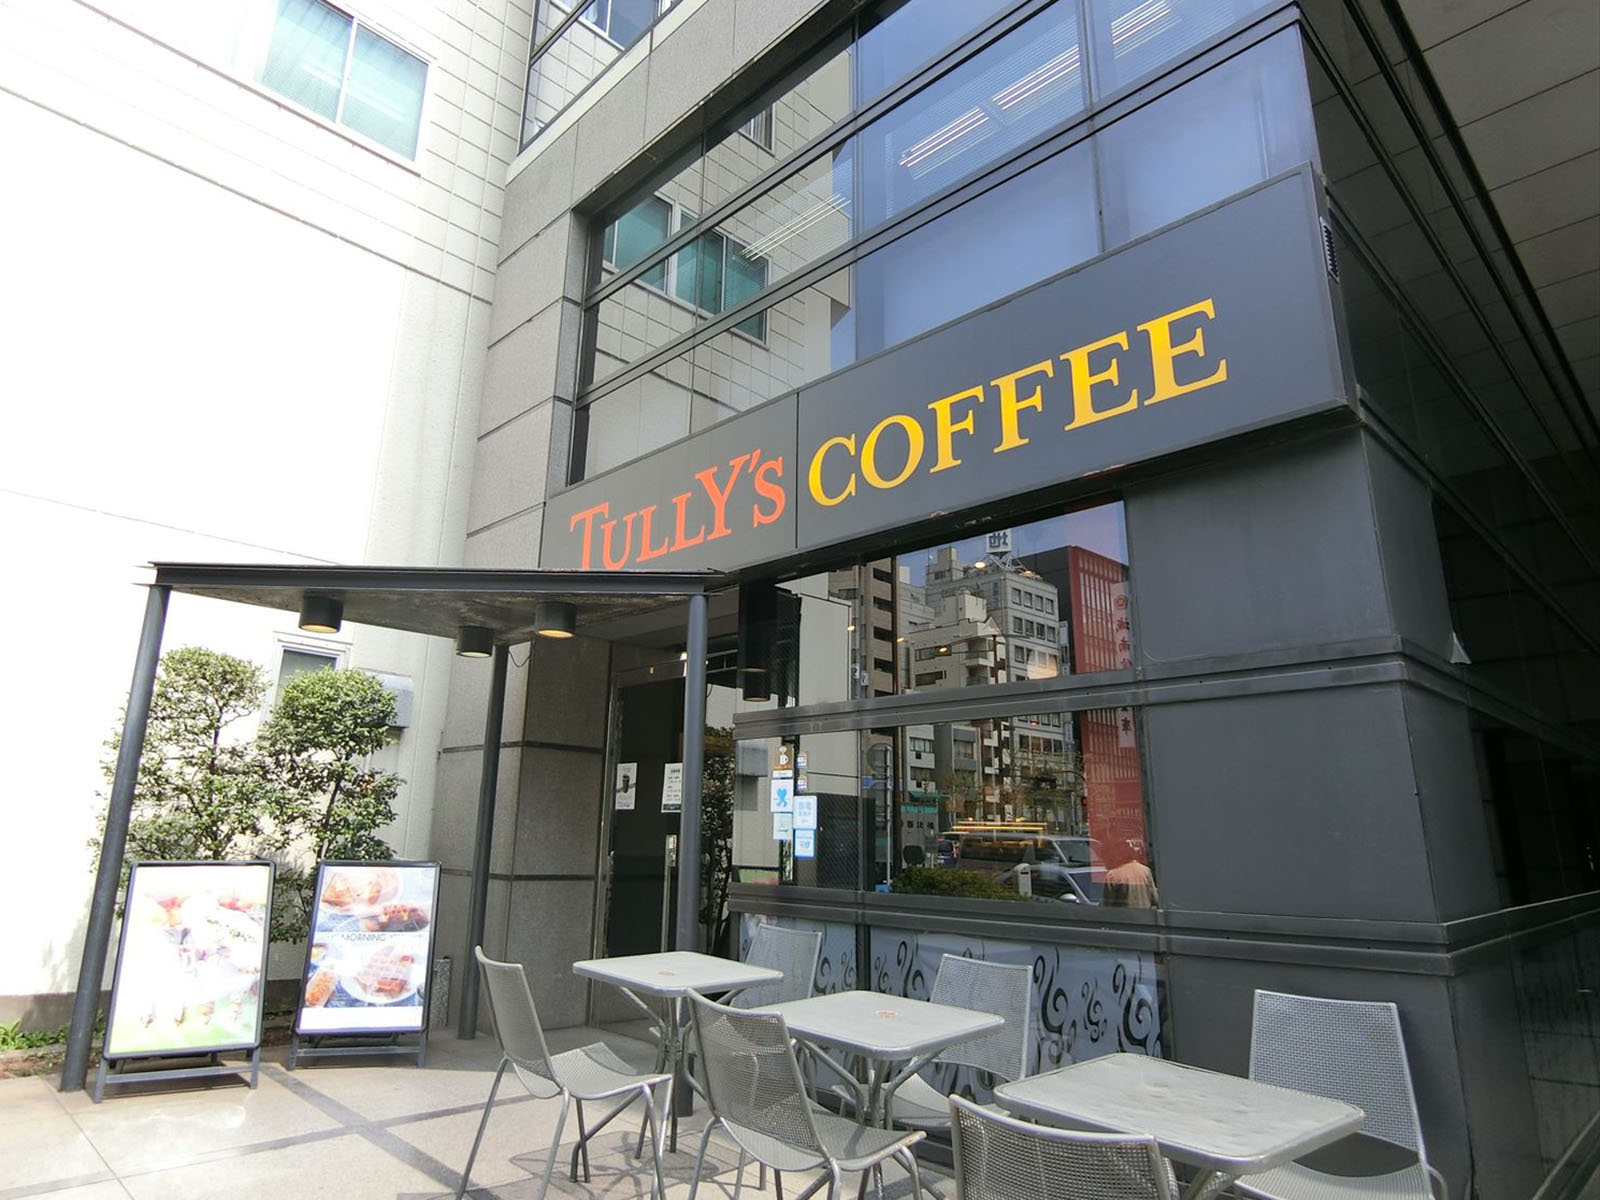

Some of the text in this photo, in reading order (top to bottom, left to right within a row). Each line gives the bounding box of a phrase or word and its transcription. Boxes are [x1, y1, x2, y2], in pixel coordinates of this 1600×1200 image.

[569, 298, 1228, 570] TULLY'S COFFEE
[341, 932, 387, 943] MORNING
